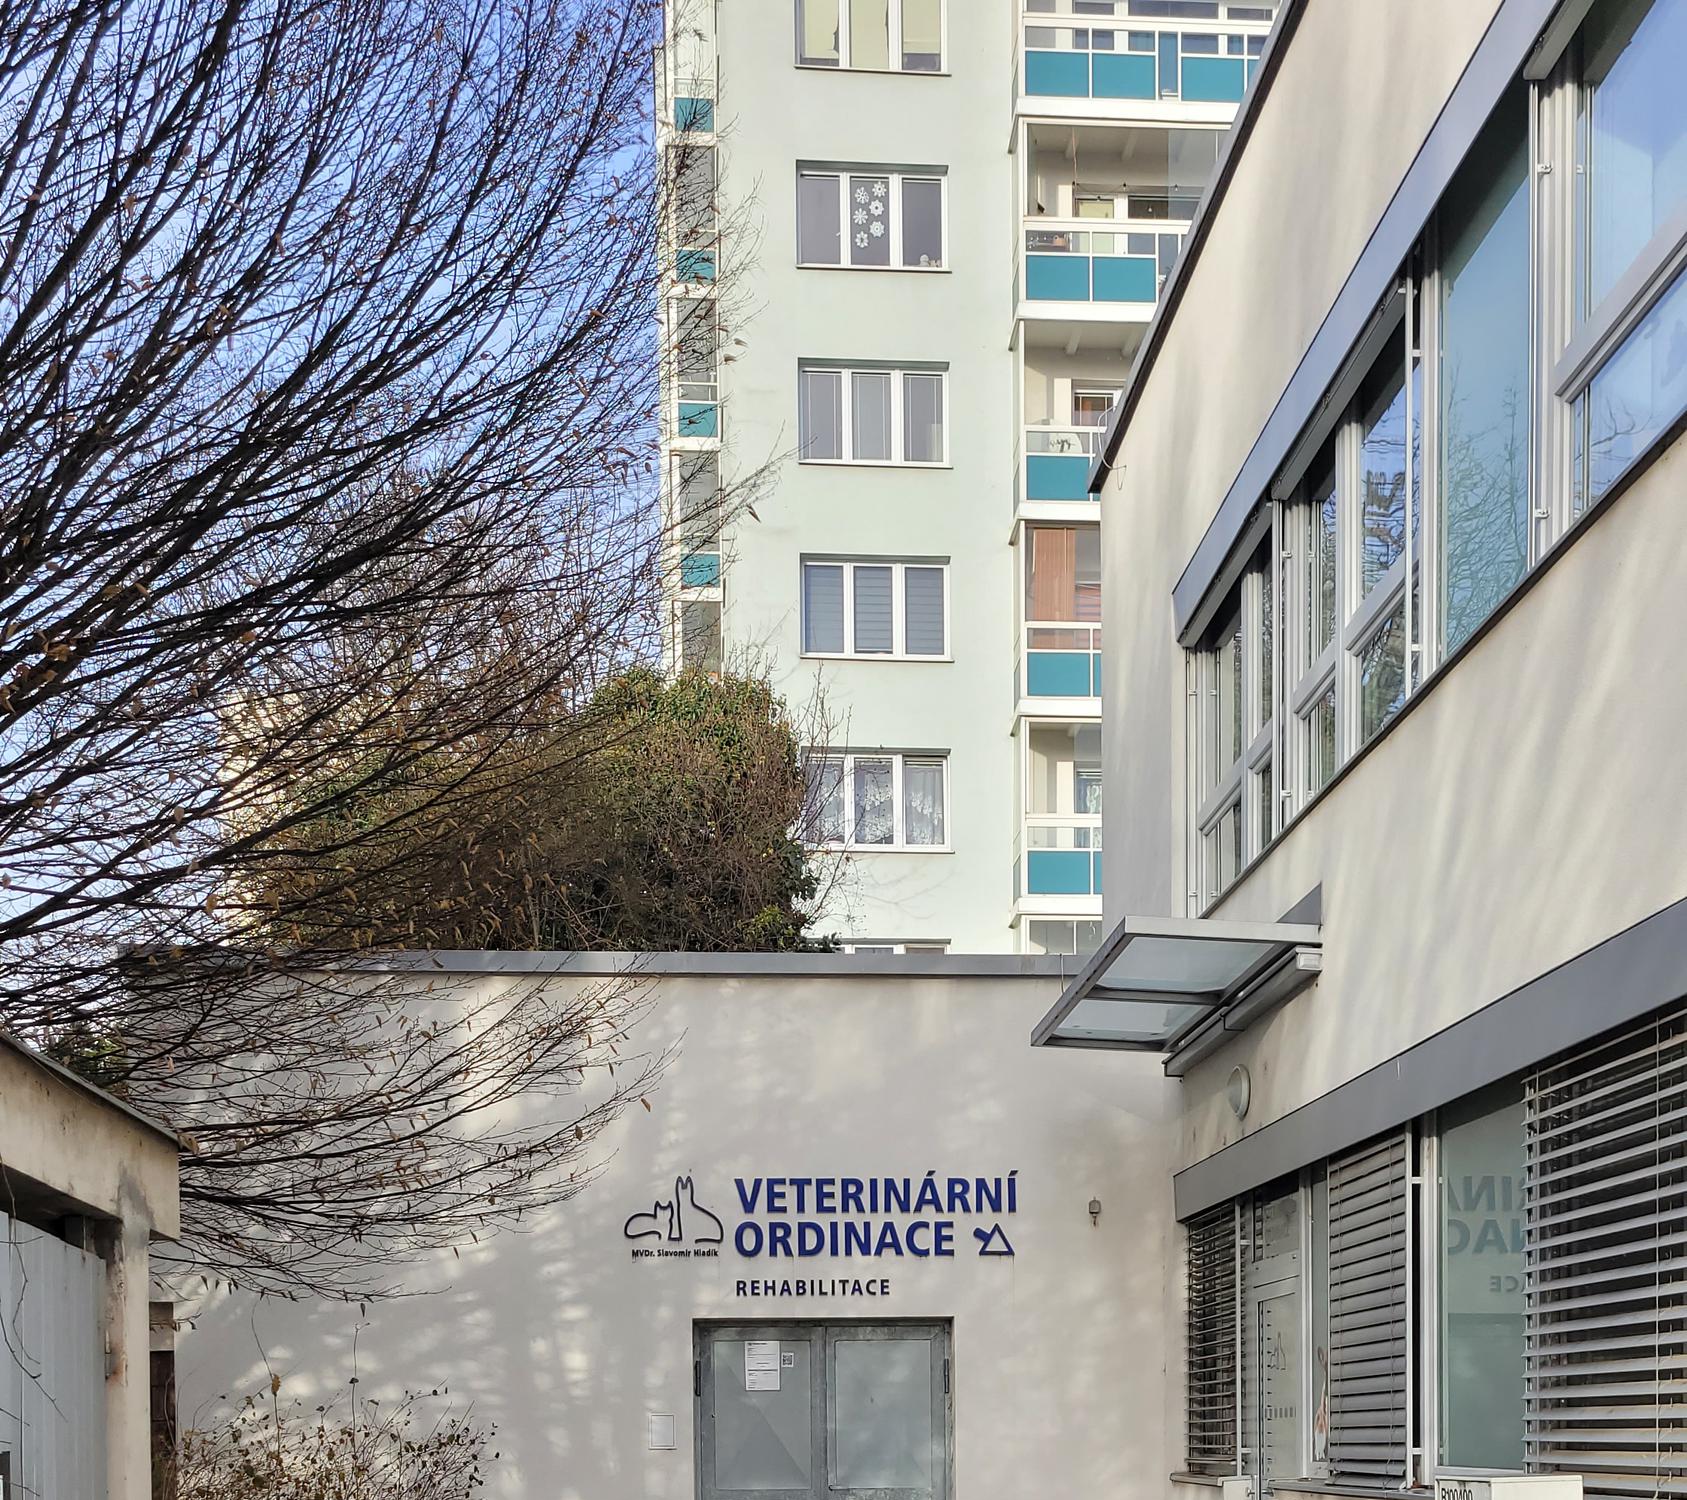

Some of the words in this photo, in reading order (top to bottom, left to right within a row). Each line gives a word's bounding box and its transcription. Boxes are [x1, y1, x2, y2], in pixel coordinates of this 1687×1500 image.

[734, 1170, 1018, 1213] VETERINÁRNÍ
[735, 1221, 954, 1257] ORDINACE
[631, 1249, 655, 1257] MVDr.
[736, 1279, 890, 1297] REHABILITACE
